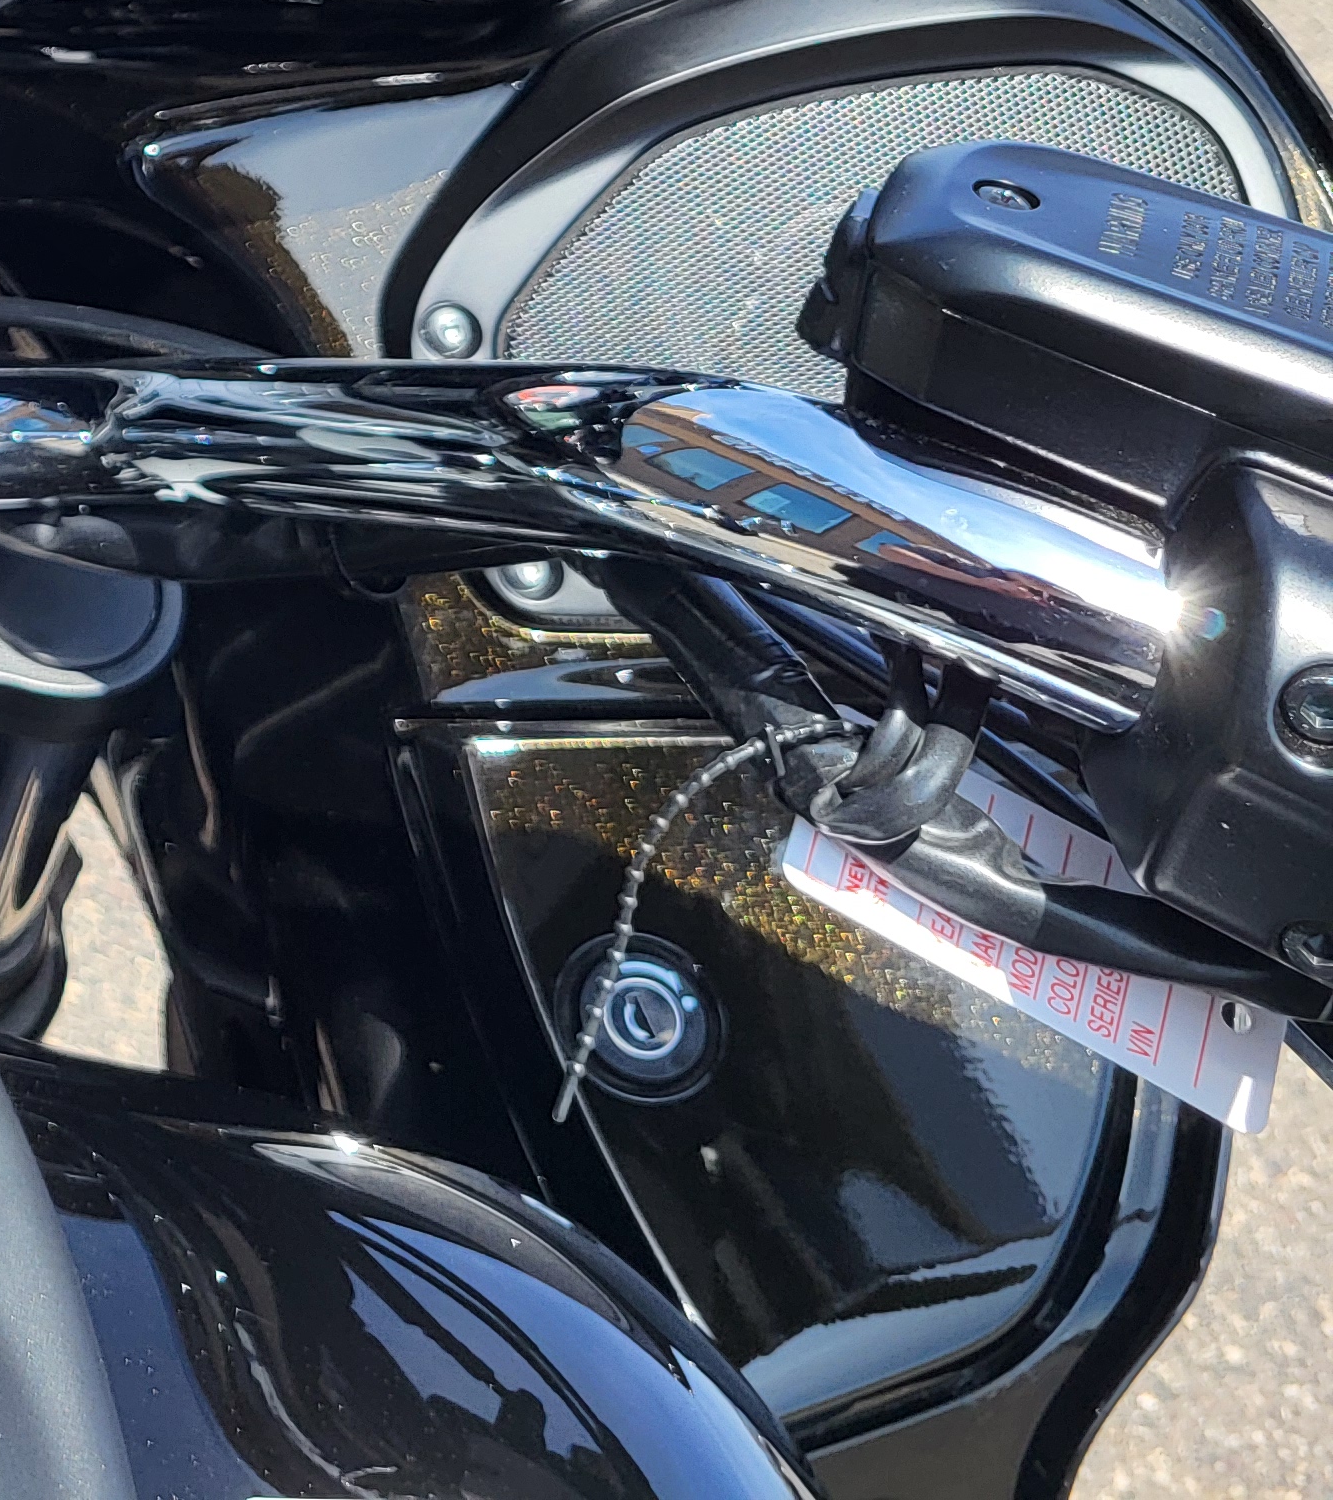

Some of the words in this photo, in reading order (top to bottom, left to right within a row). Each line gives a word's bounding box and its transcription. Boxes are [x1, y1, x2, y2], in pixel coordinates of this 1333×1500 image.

[1099, 191, 1146, 258] WARNING
[1087, 967, 1125, 1039] SERIES
[1126, 1020, 1157, 1058] VIN
